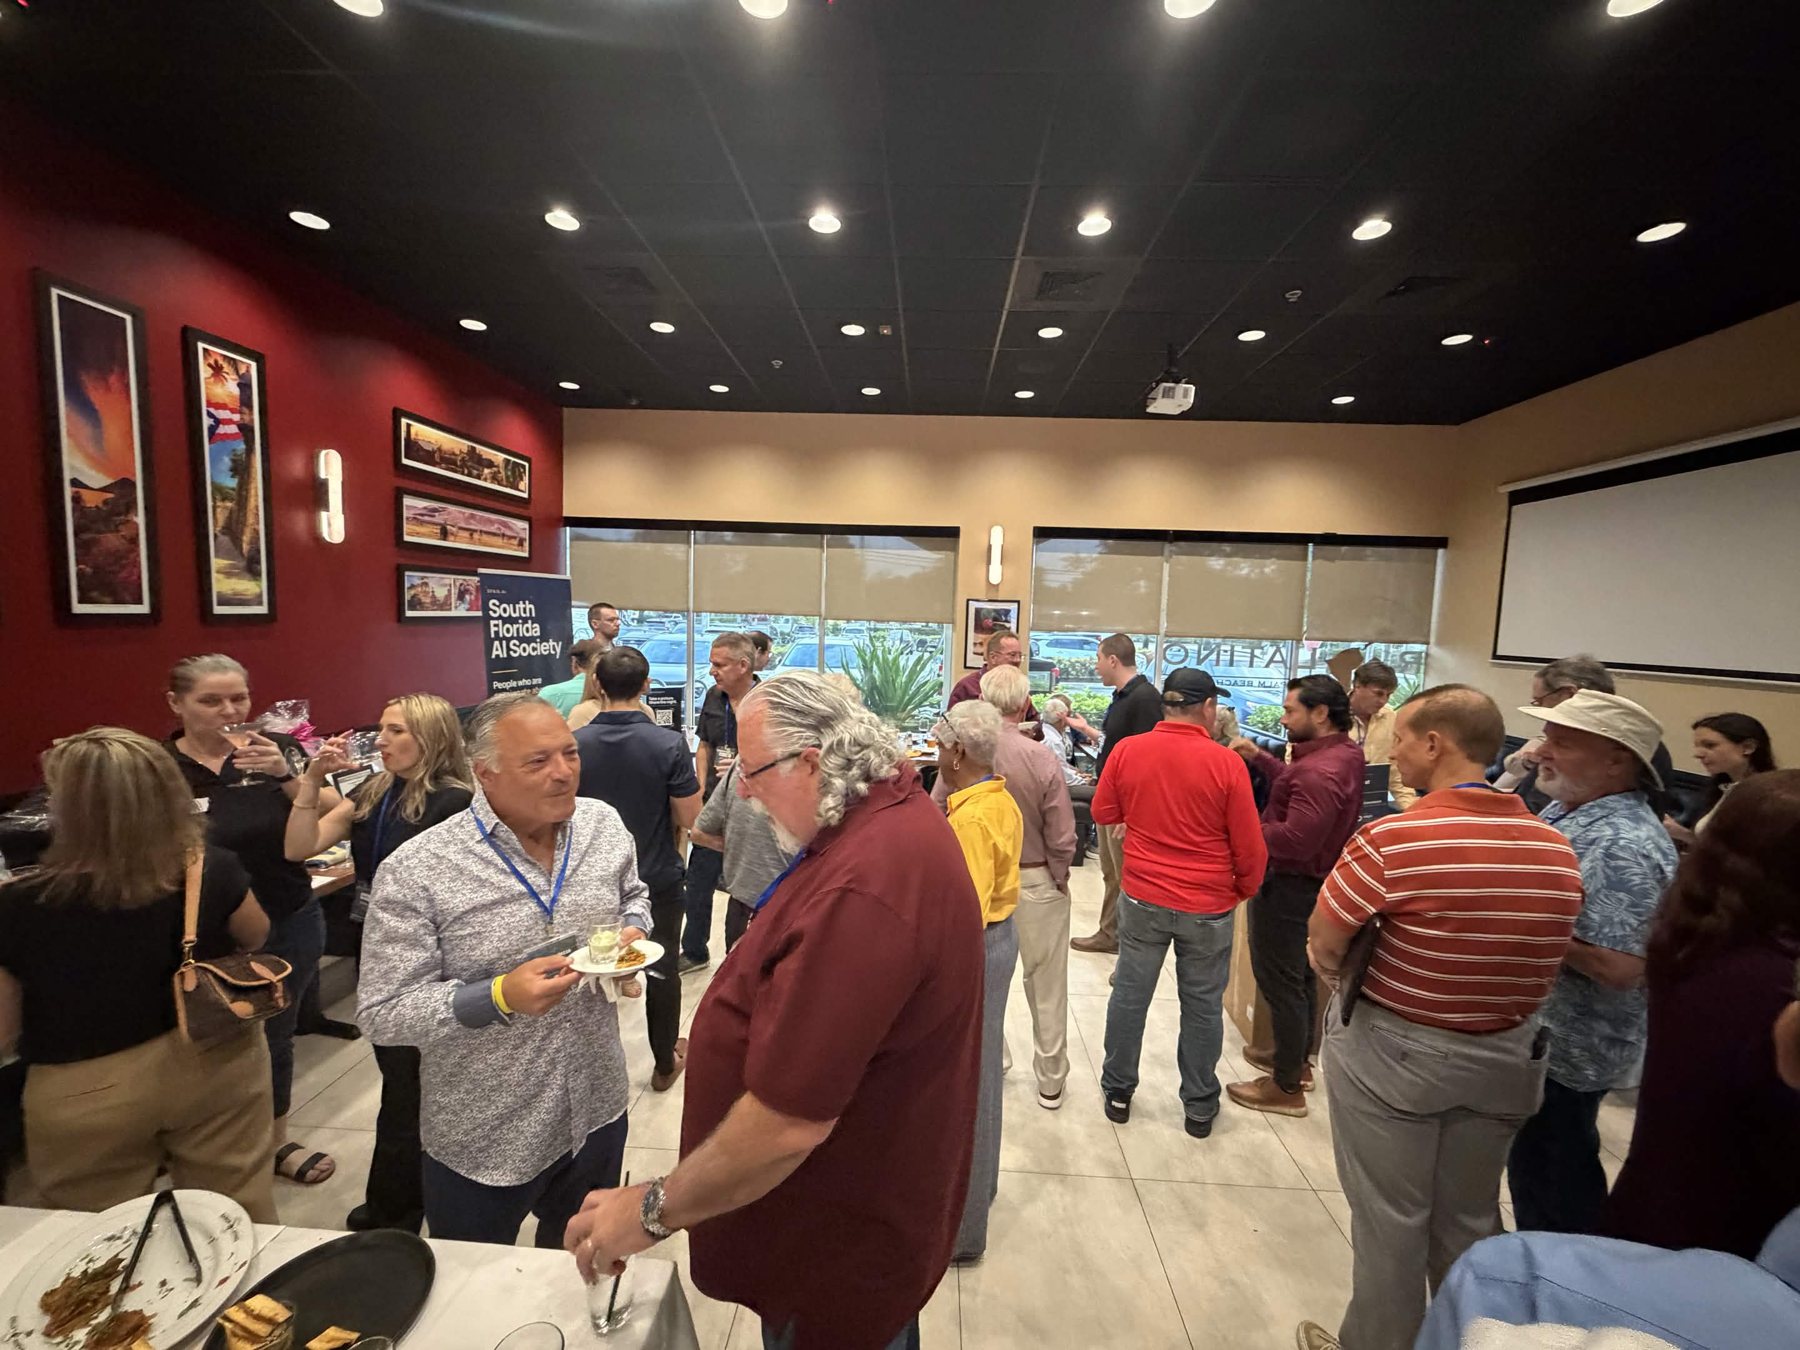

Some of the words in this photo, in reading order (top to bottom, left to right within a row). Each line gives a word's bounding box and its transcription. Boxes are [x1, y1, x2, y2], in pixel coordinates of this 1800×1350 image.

[488, 598, 536, 618] South
[489, 619, 541, 639] Florida
[491, 640, 507, 659] AI
[509, 638, 563, 660] Society
[492, 679, 517, 691] People
[517, 678, 532, 686] who
[532, 677, 543, 685] are
